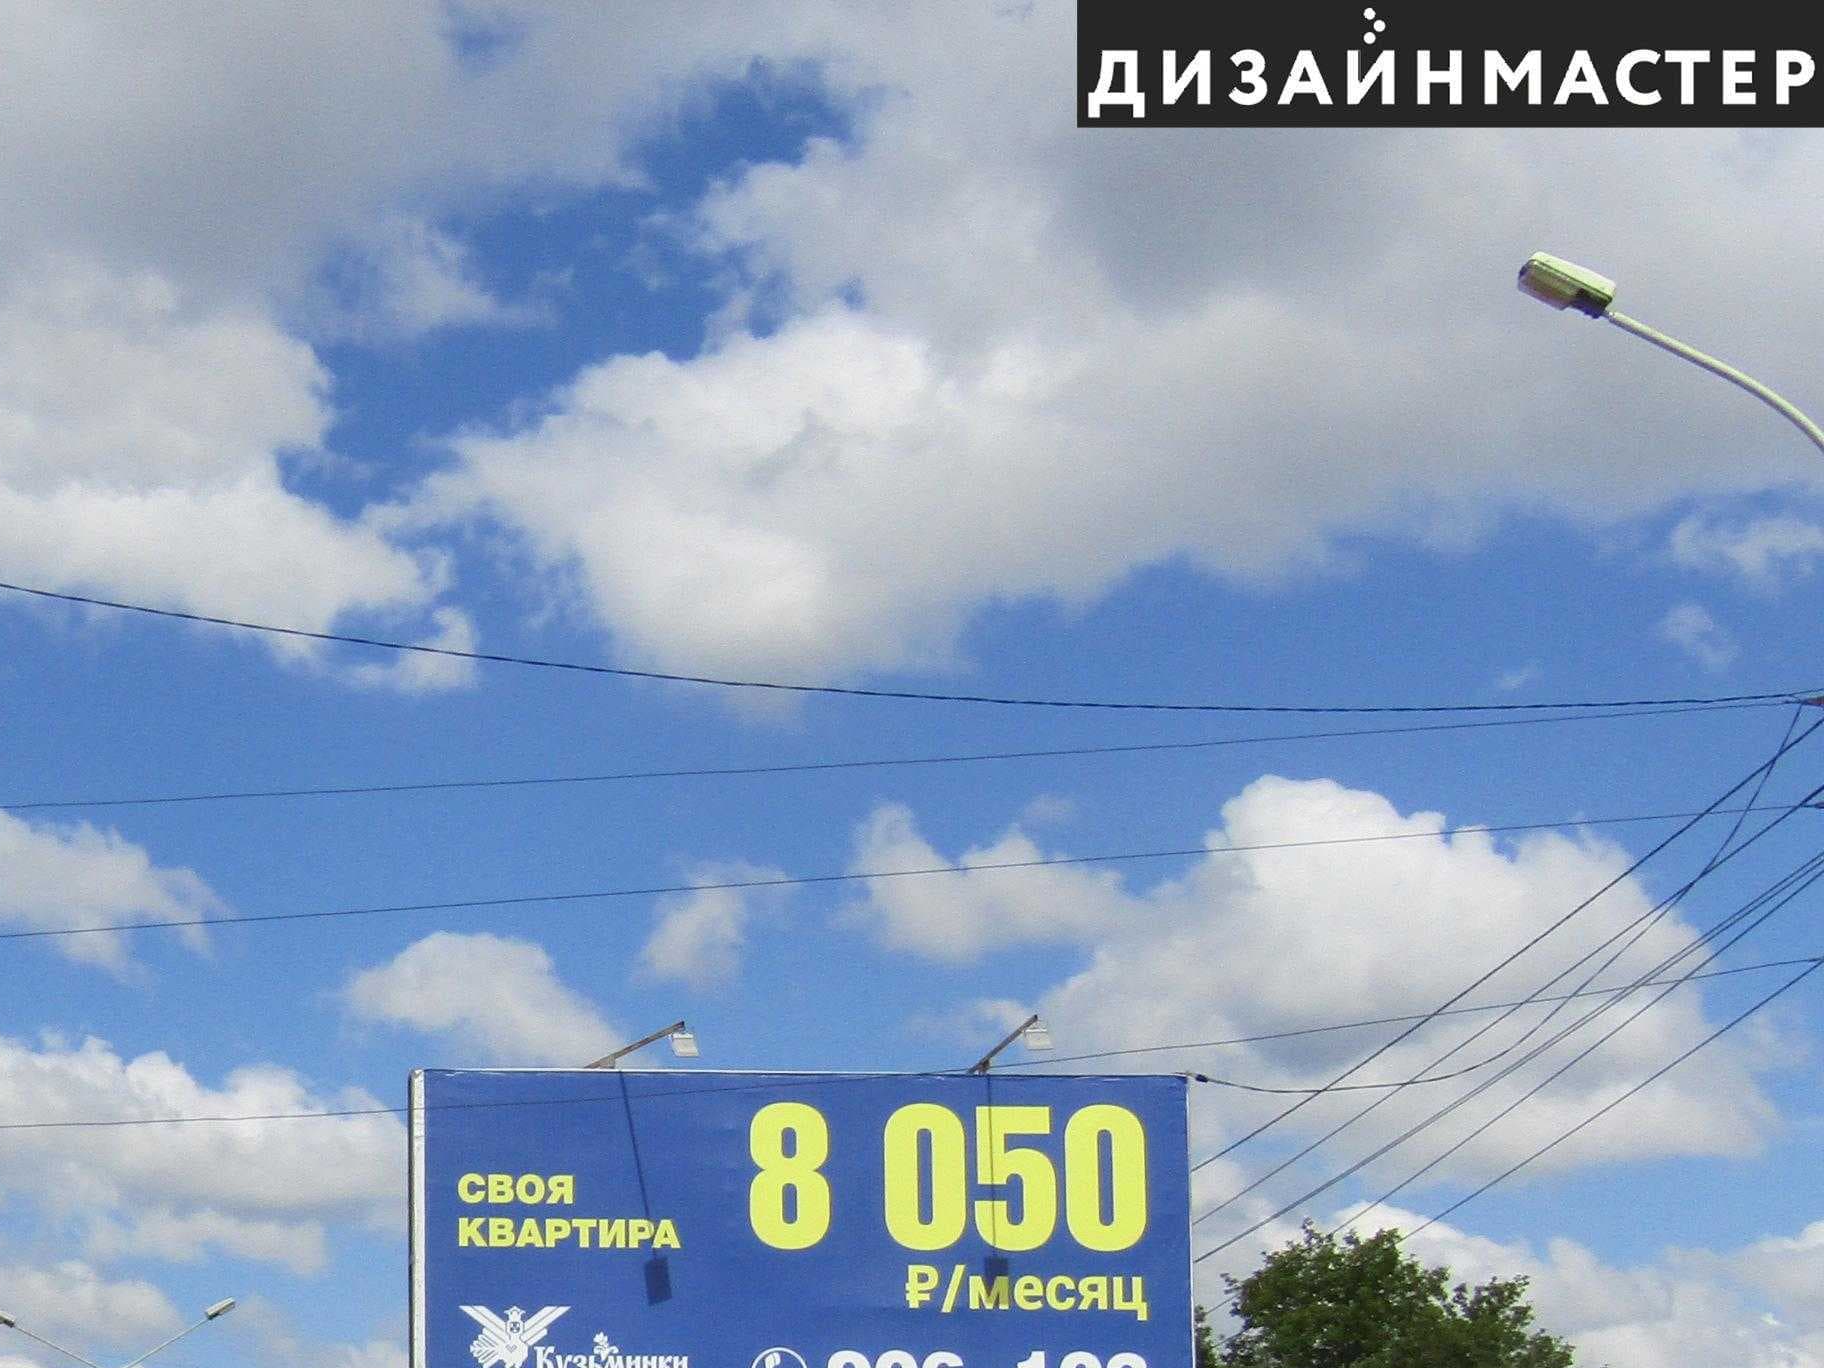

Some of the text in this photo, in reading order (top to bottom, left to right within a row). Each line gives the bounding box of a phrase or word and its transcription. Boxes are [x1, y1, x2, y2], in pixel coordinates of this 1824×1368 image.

[457, 1173, 575, 1205] СВОЯ
[749, 1102, 1147, 1252] 8 050
[458, 1218, 681, 1249] КВАРТИРА
